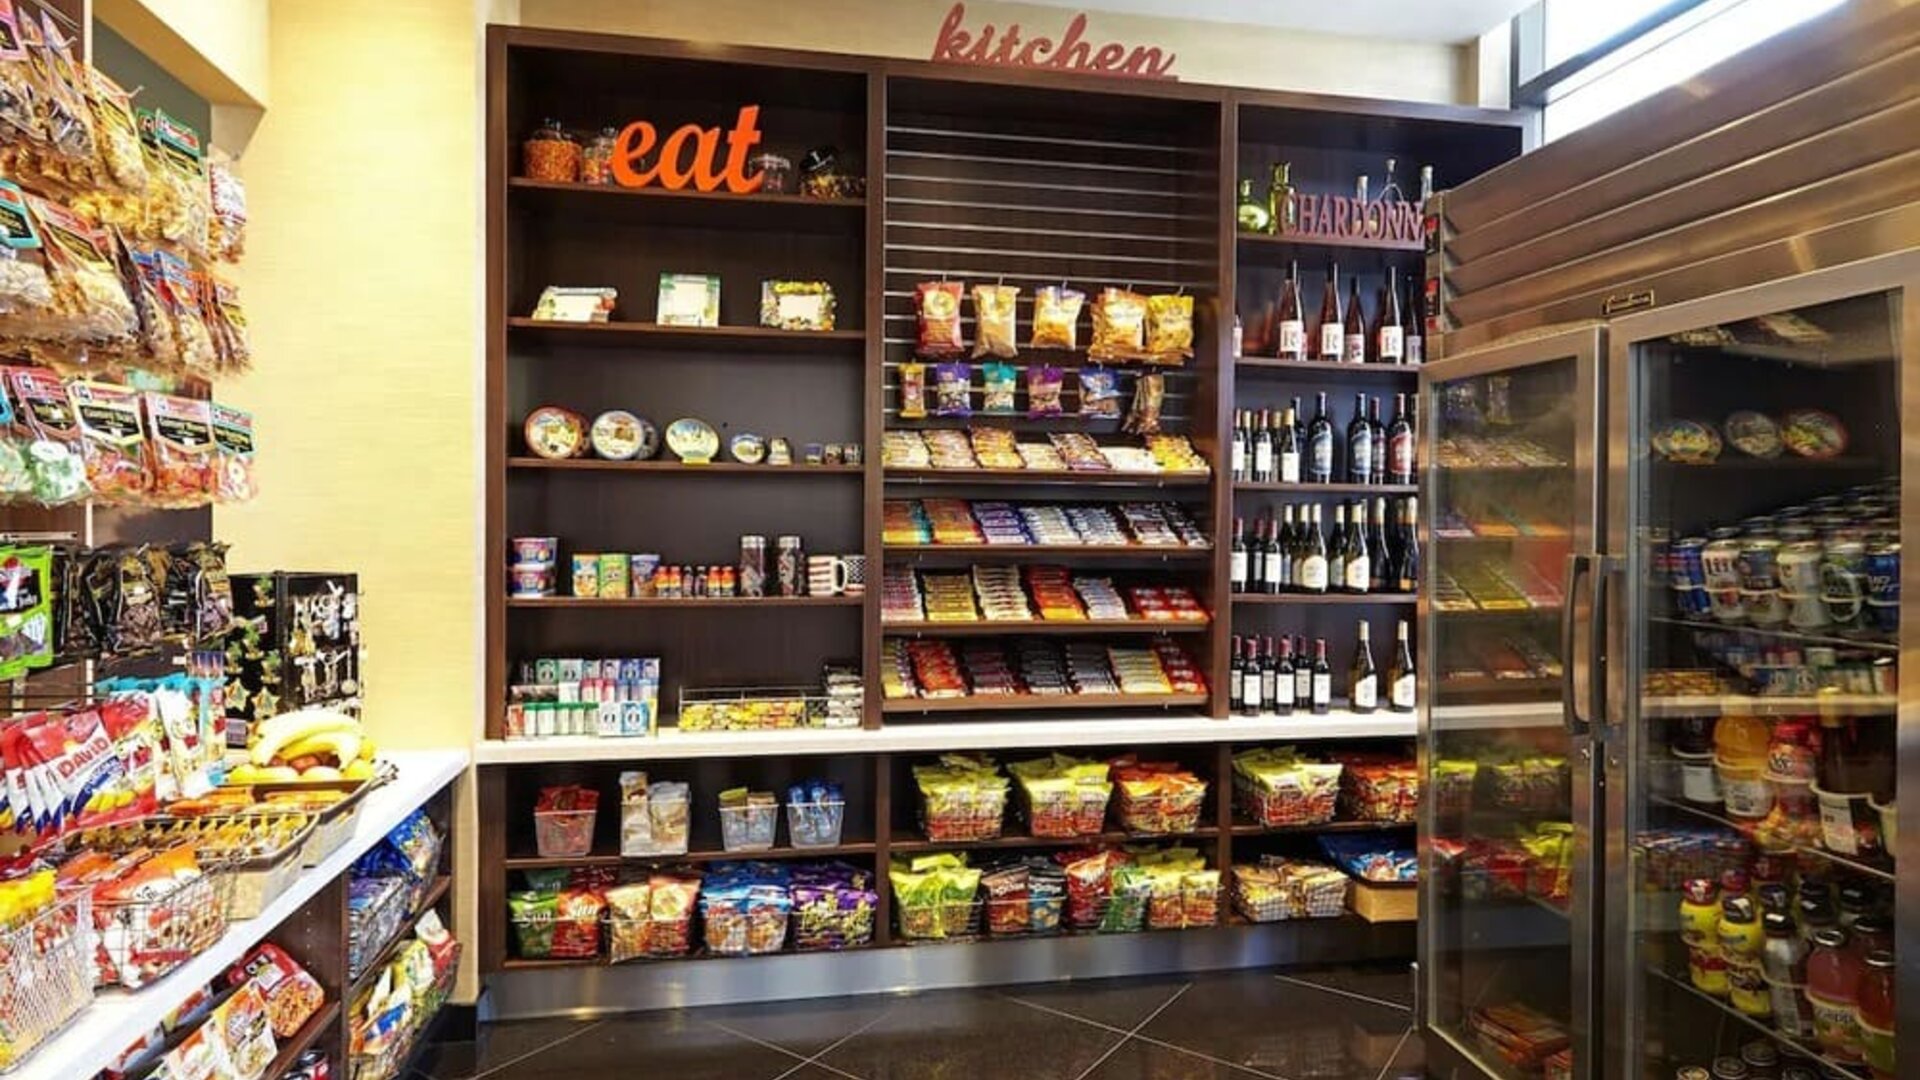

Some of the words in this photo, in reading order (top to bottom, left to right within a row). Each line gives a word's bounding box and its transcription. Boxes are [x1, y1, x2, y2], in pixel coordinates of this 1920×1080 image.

[931, 2, 1177, 81] kitchen
[612, 104, 764, 194] eat
[1281, 192, 1425, 242] CHARDONN
[58, 737, 110, 779] DAVID
